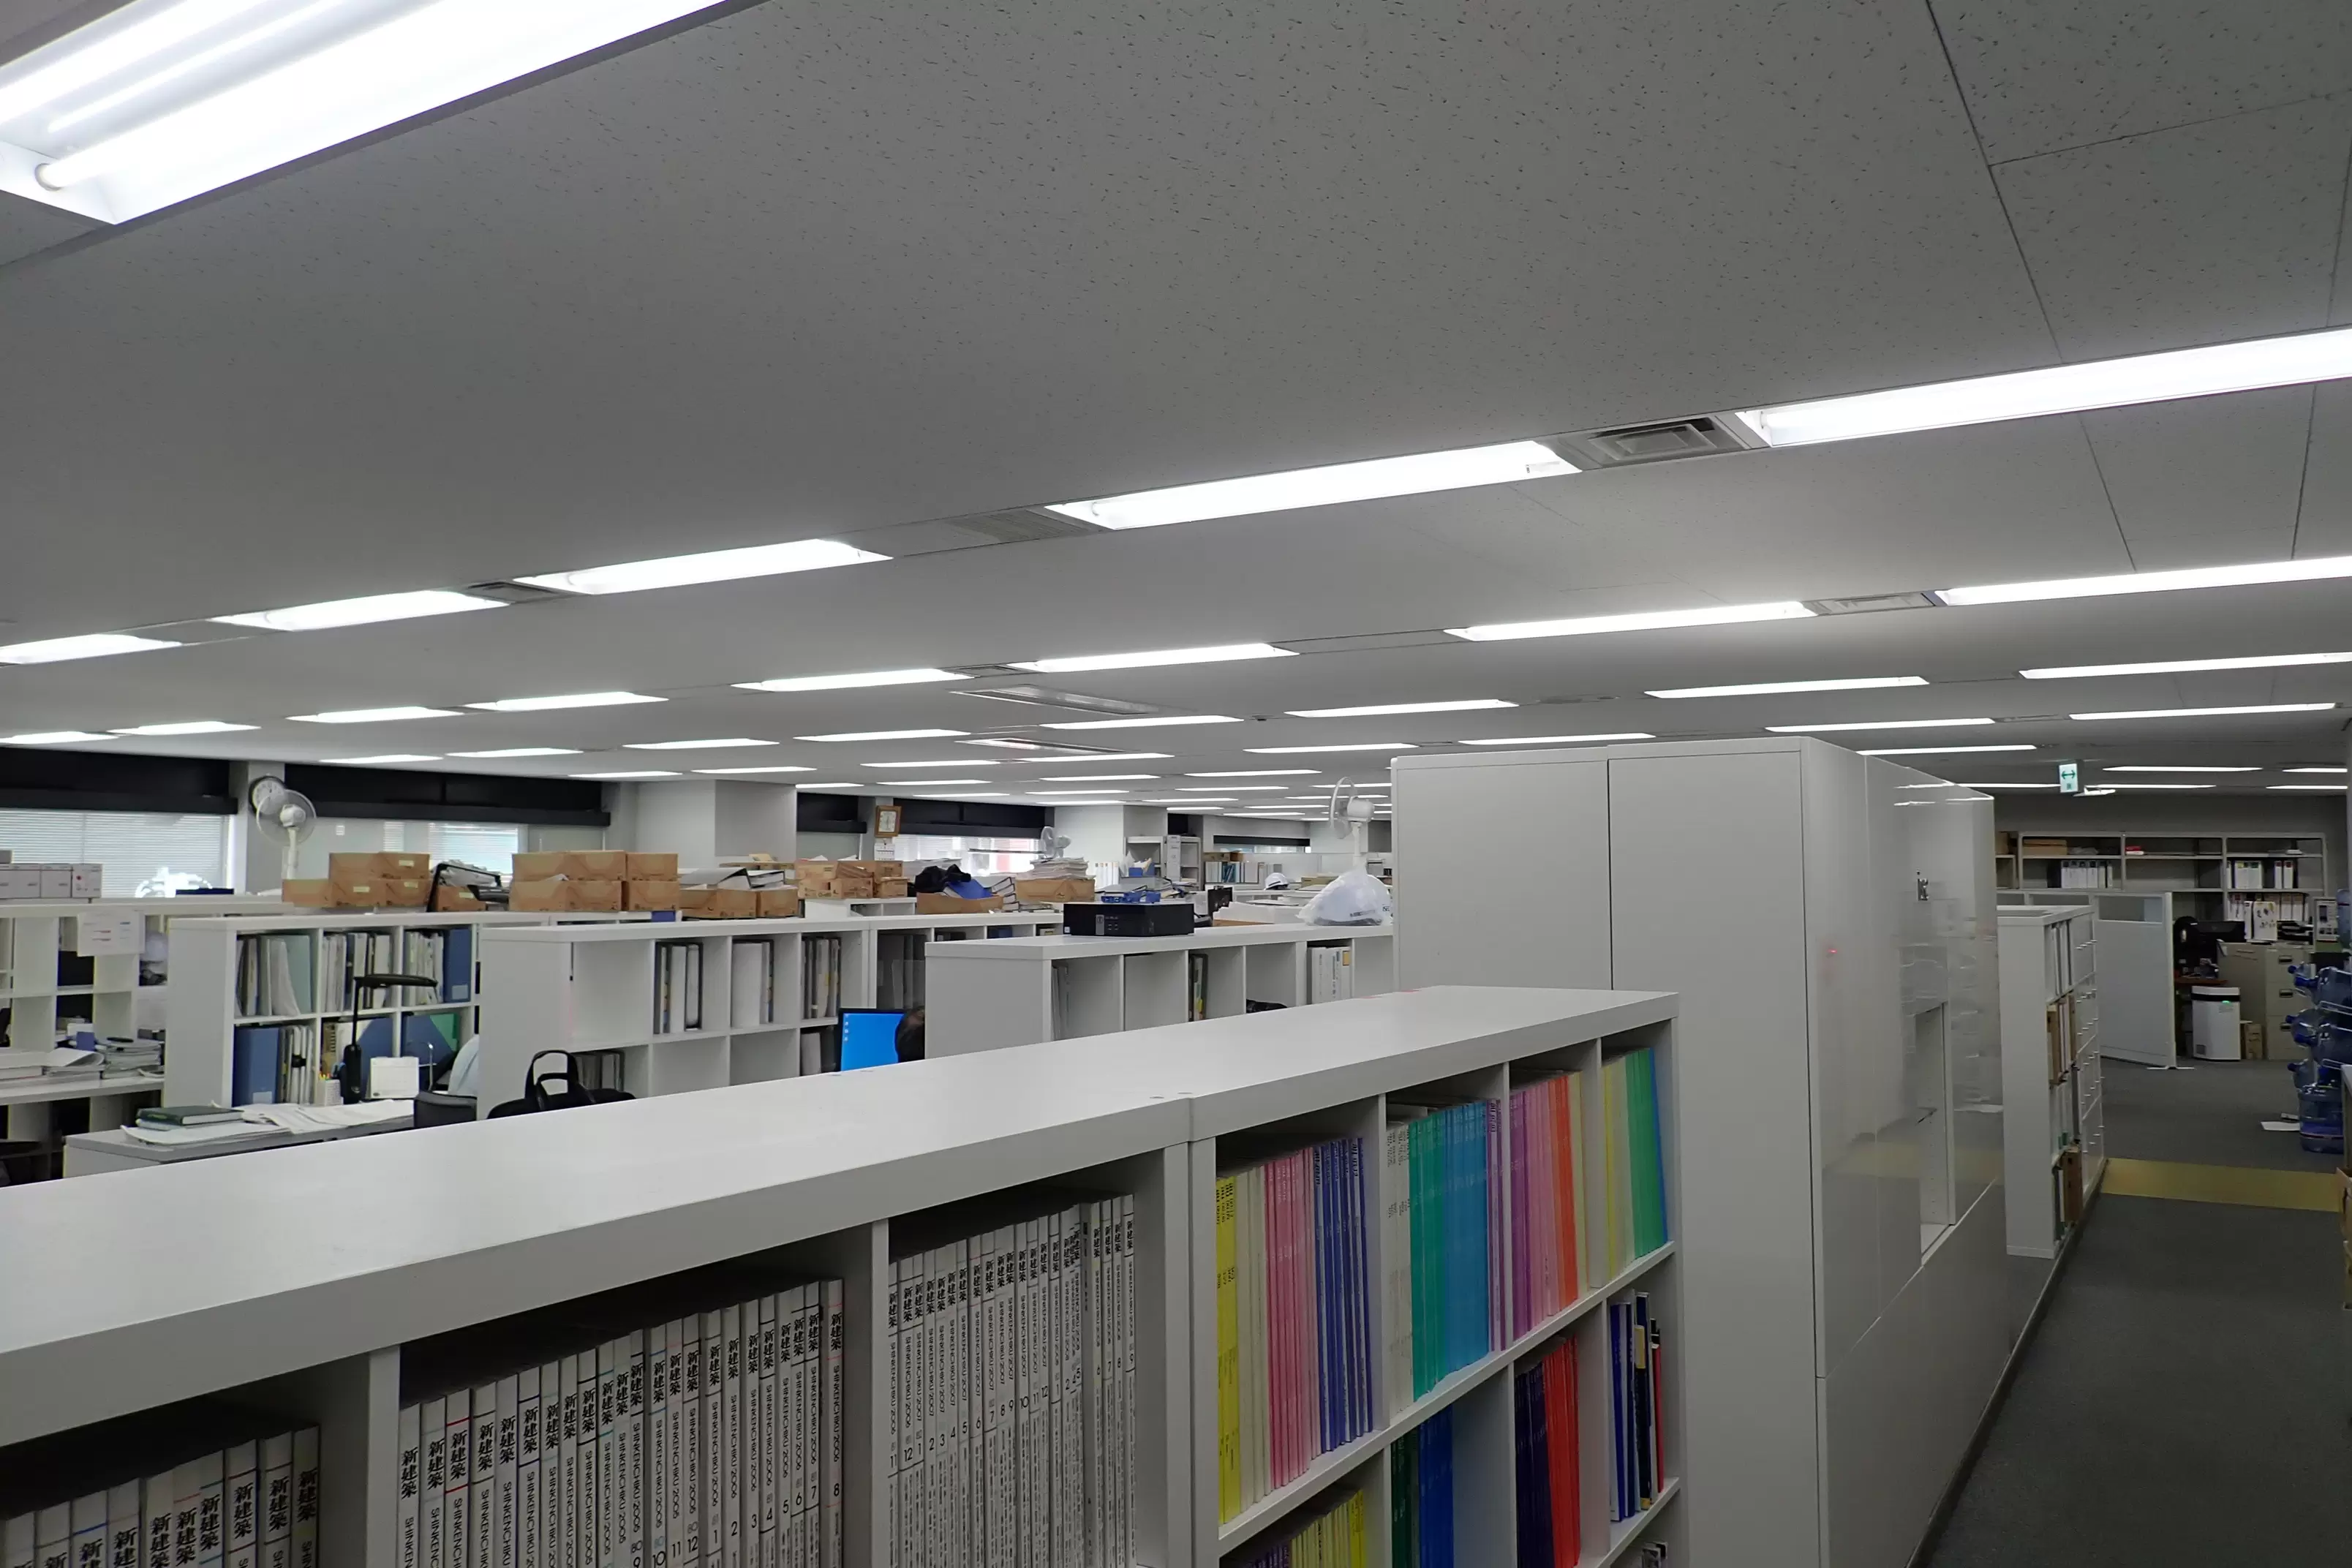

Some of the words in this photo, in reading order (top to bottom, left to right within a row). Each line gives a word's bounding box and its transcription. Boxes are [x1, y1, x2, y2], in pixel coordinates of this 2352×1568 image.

[889, 1292, 898, 1328] 新建築
[764, 1329, 774, 1370] 新建築
[780, 1323, 791, 1363] 新建築
[794, 1317, 804, 1357] 新建築
[808, 1313, 818, 1352] 新建築
[831, 1312, 842, 1352] 新建築
[669, 1353, 681, 1395] 新建築
[687, 1351, 698, 1393] 新建築
[709, 1345, 720, 1387] 新建築
[728, 1338, 739, 1380] 新建築
[748, 1333, 758, 1375] 新建築
[616, 1372, 628, 1417] 新建築
[631, 1363, 643, 1406] 新建築
[654, 1360, 665, 1404] 新建築
[564, 1393, 578, 1440] 新建築
[582, 1387, 596, 1434] 新建築
[600, 1381, 614, 1426] 新建築
[478, 1422, 494, 1472] 新建築
[500, 1416, 516, 1464] 新建築
[524, 1406, 538, 1455] 新建築
[546, 1403, 559, 1450] 新建築
[427, 1438, 445, 1490] 新建築
[450, 1430, 467, 1481] 新建築
[891, 1454, 897, 1469] 11
[904, 1448, 913, 1462] 12
[919, 1444, 921, 1455] 1
[402, 1447, 418, 1499] 新建築
[811, 1485, 816, 1499] 7
[834, 1482, 840, 1496] 8
[234, 1482, 253, 1539] 新建築
[269, 1477, 289, 1532] 新建築
[298, 1467, 317, 1522] 新建築
[527, 1471, 535, 1554] SHINKENCHIKU
[549, 1466, 557, 1548] SHINKENCHIKU
[766, 1507, 772, 1520] 4
[783, 1499, 788, 1514] 5
[796, 1492, 802, 1506] 6
[176, 1508, 196, 1566] 新建築
[200, 1494, 219, 1550] 新建築
[503, 1482, 512, 1566] SHINKENCHIKU
[731, 1521, 737, 1537] 2
[752, 1514, 757, 1529] 3
[652, 1551, 666, 1568] 10
[672, 1542, 681, 1558] 11
[687, 1536, 698, 1553] 12
